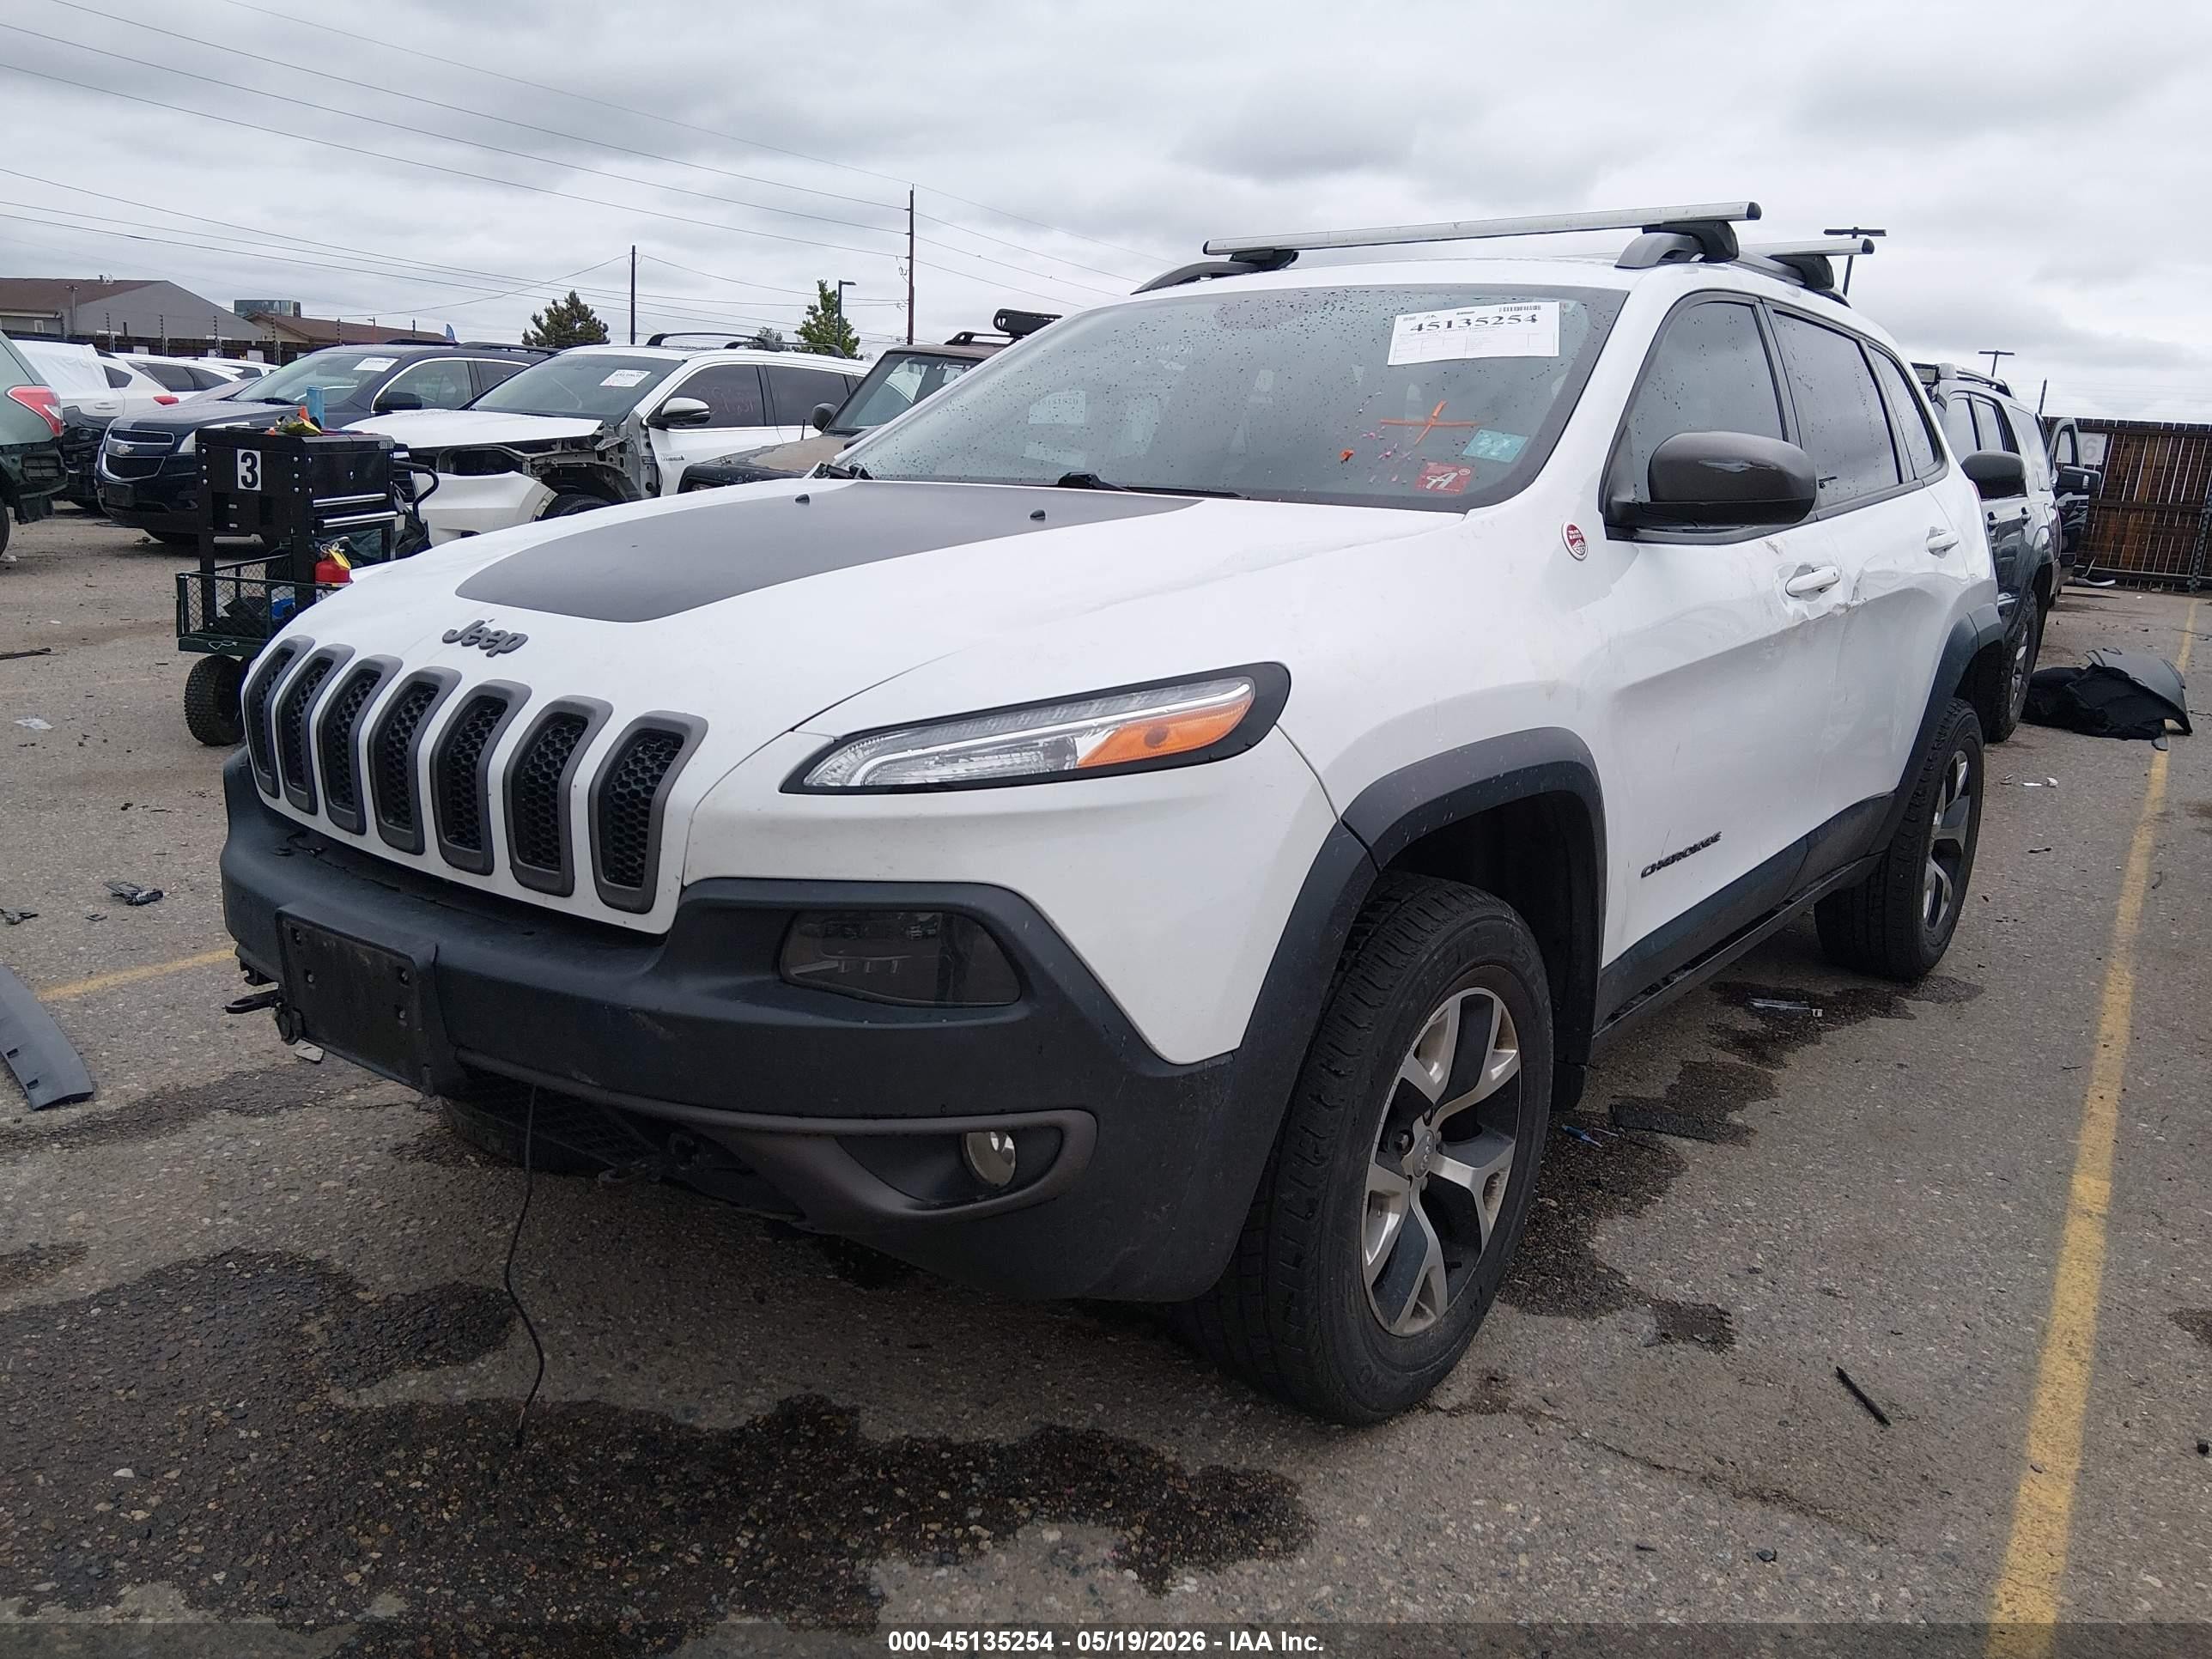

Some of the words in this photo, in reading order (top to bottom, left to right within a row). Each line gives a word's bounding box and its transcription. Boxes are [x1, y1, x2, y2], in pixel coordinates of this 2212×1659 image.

[1410, 313, 1539, 332] 45135254
[2083, 438, 2098, 459] 6
[240, 452, 258, 489] 3
[442, 619, 529, 658] Jeep
